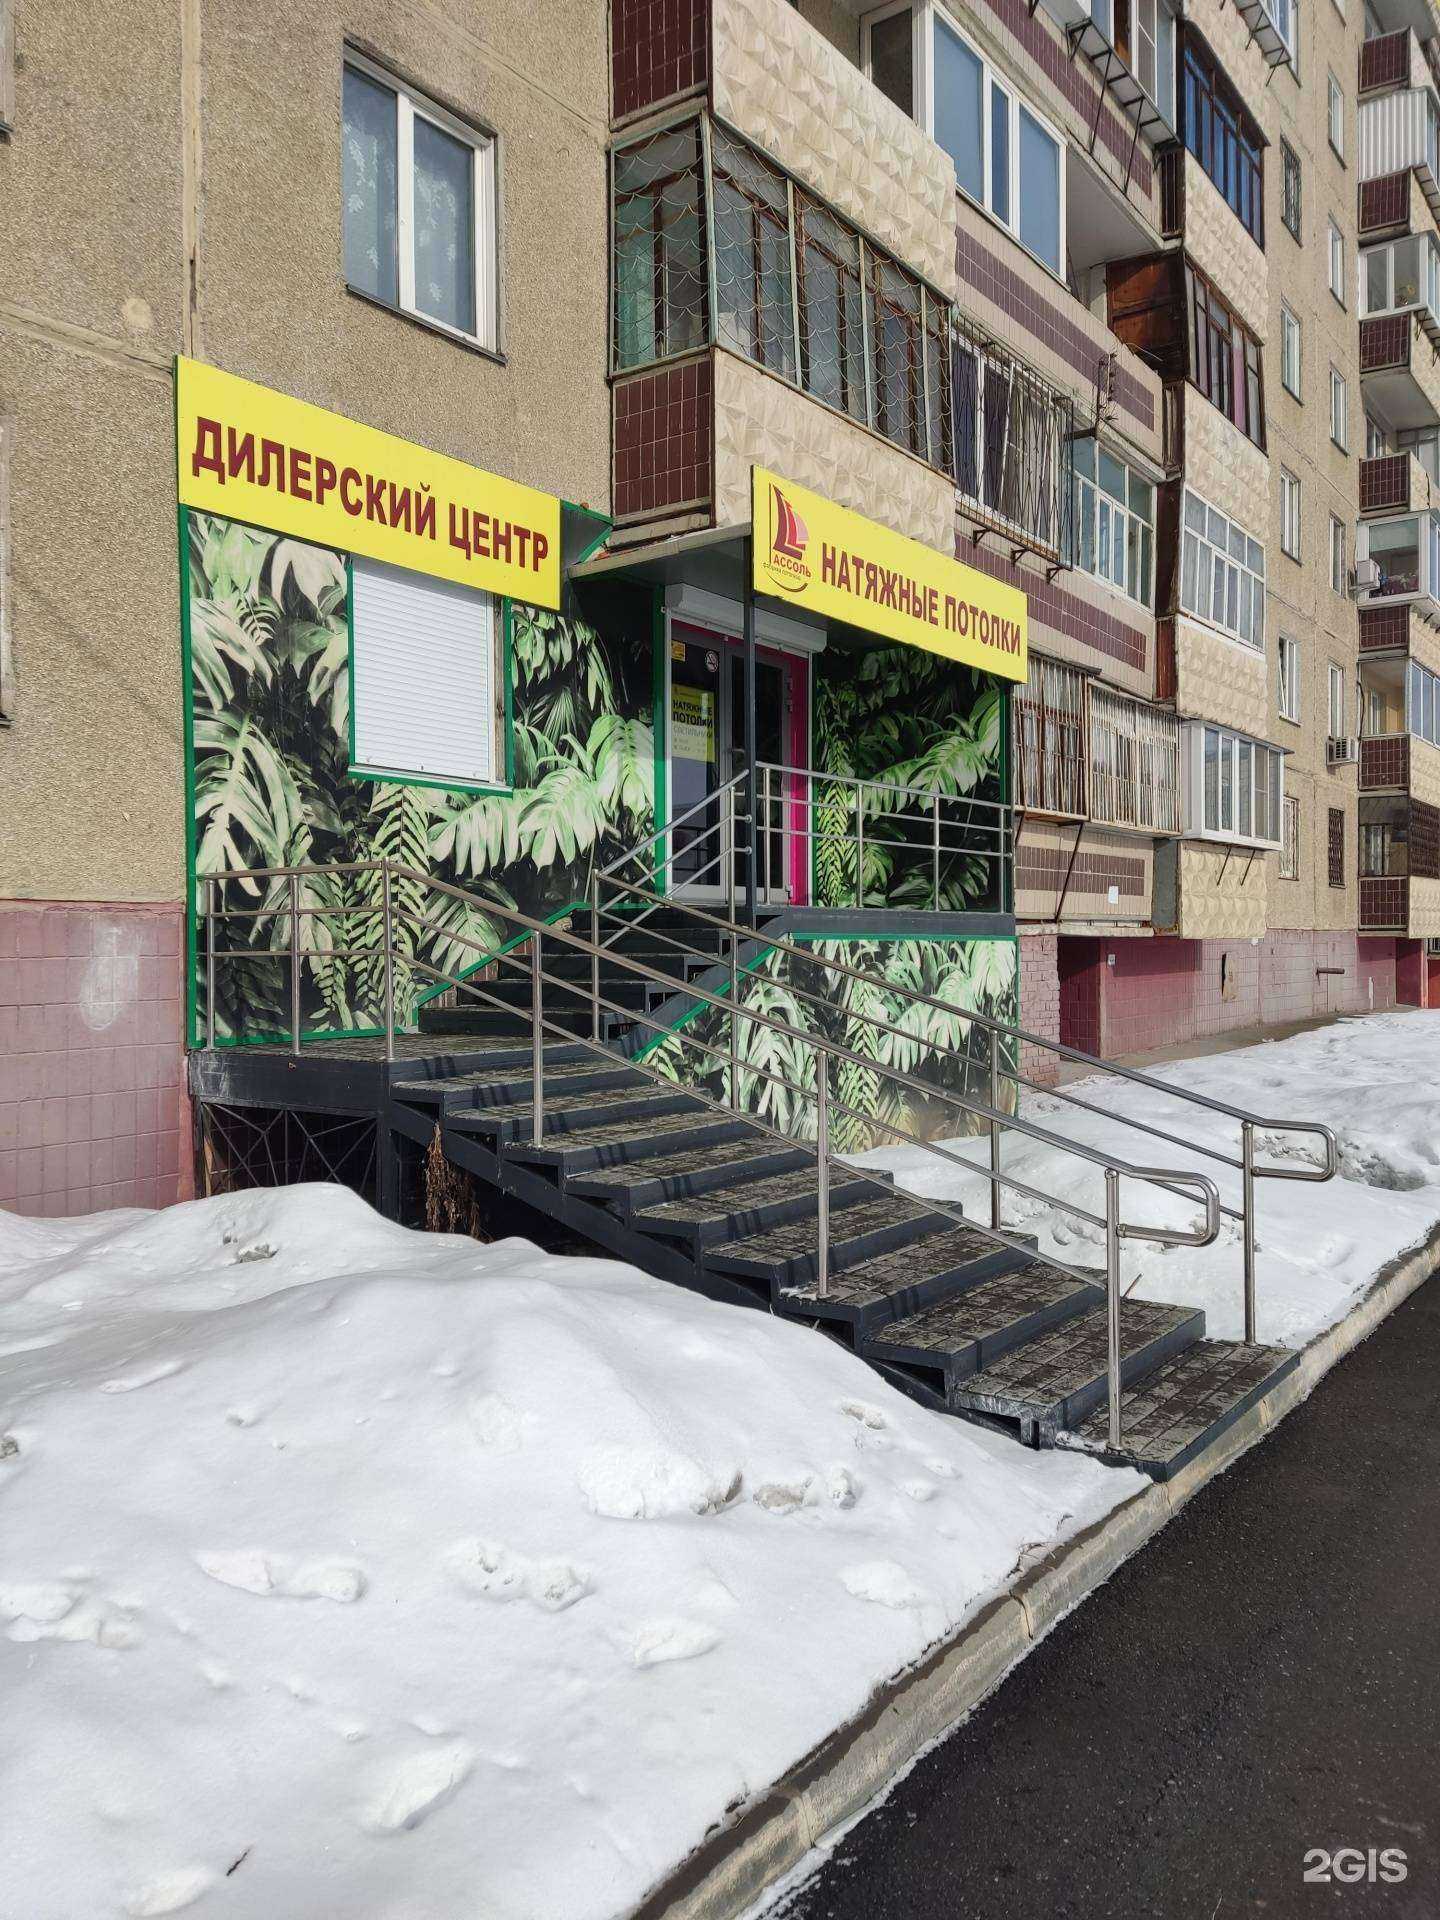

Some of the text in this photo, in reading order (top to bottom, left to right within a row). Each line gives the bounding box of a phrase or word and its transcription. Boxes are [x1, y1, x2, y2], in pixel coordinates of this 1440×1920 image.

[192, 416, 549, 573] ДИЛЕРСКИЙ ЦЕНТР
[773, 553, 812, 578] АССОЛЬ
[821, 541, 1022, 657] НАТЯЖНЫЕ ПОТОЛКИ
[672, 699, 713, 717] НАТЯЖНЕ
